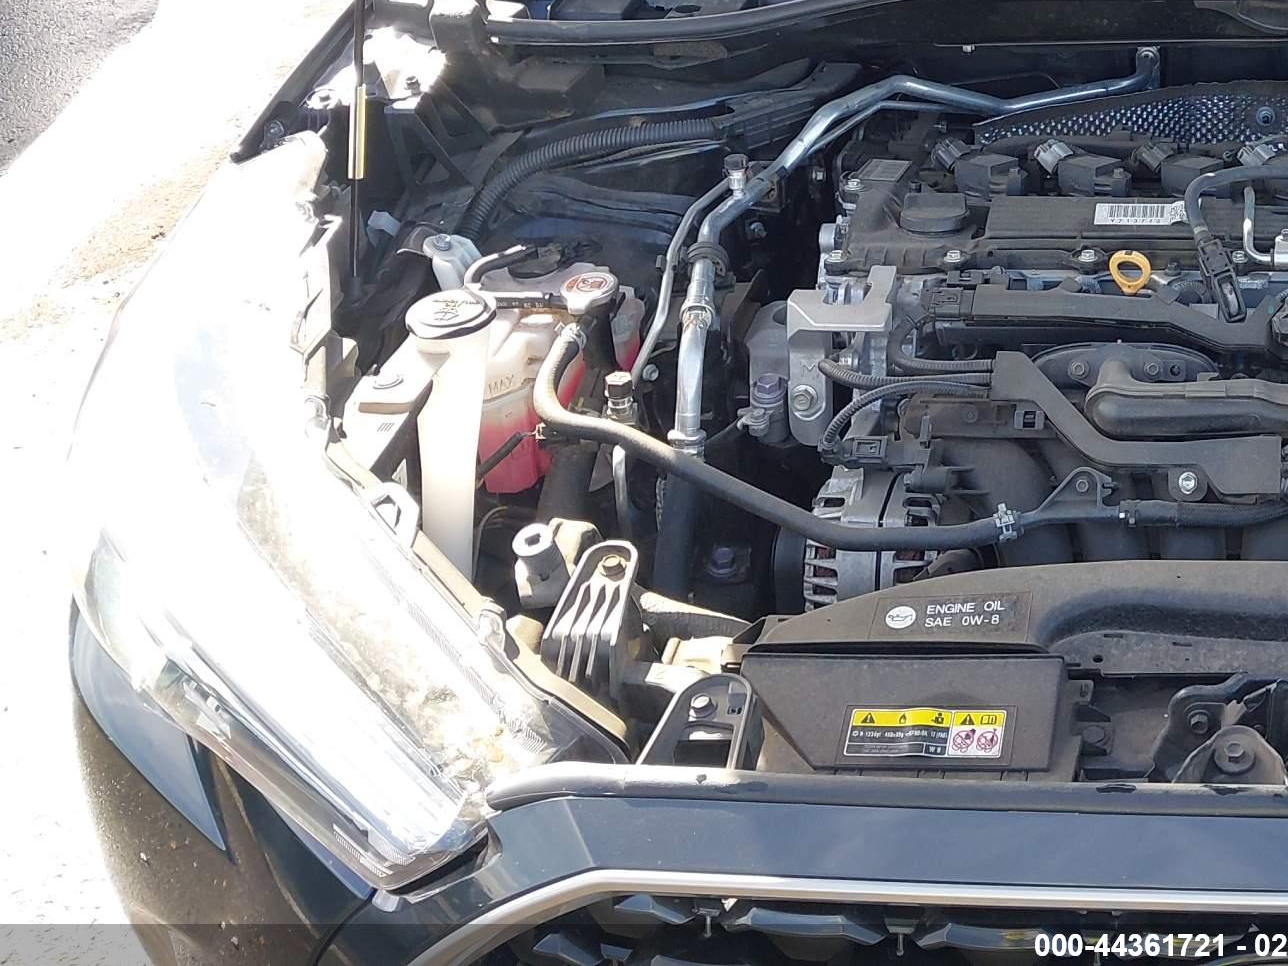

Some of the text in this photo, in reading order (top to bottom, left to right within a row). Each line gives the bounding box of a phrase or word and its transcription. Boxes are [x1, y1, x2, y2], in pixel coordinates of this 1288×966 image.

[926, 600, 1005, 615] ENGINE OIL
[924, 614, 1000, 627] SAE 0W-8
